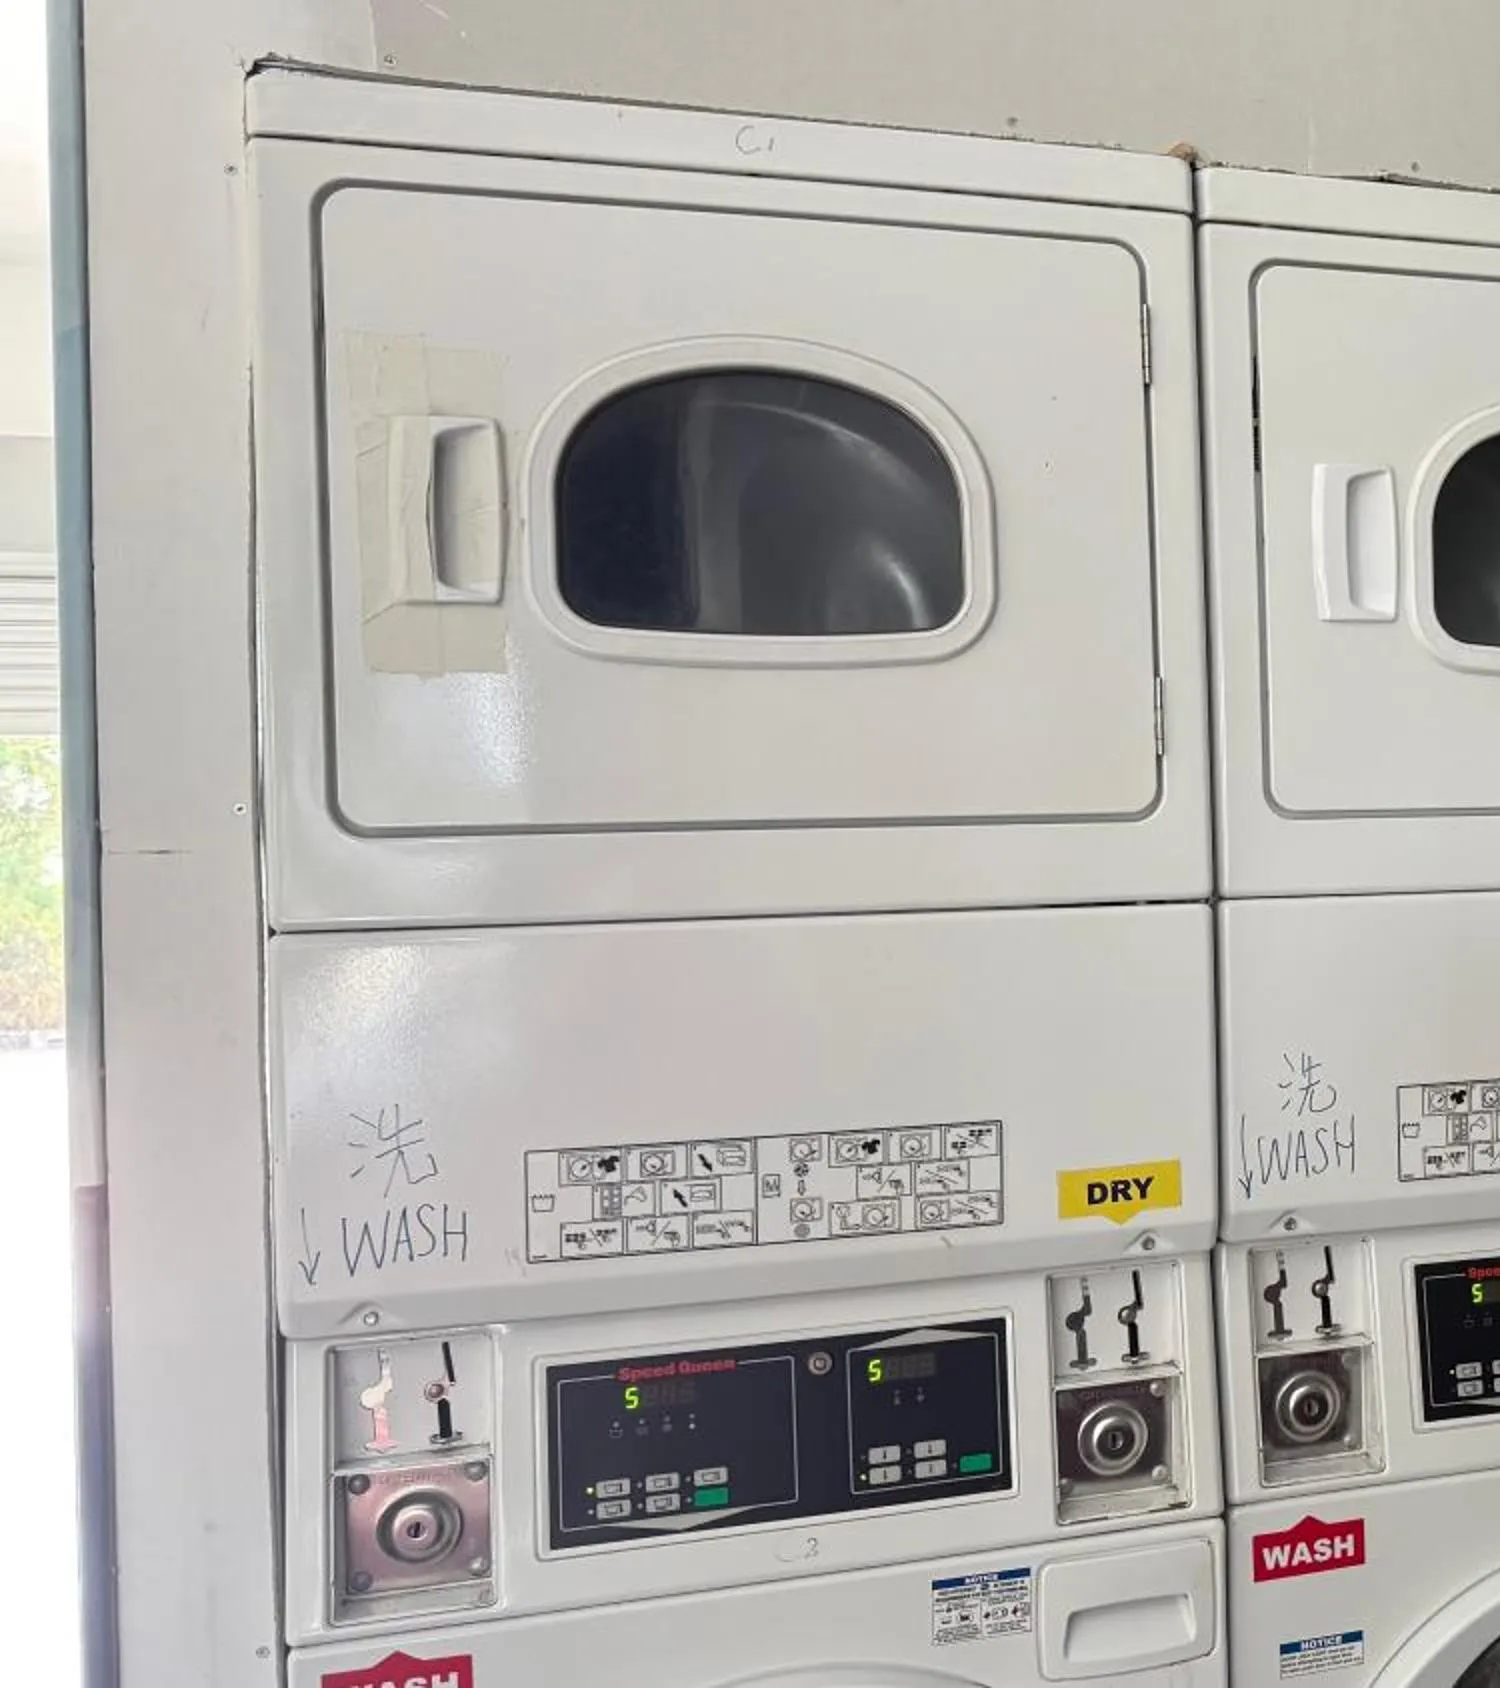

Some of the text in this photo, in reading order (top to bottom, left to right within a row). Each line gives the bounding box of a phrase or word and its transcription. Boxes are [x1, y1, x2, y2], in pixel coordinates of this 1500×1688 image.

[1278, 1052, 1337, 1117] 洗
[347, 1103, 439, 1198] 洗
[1257, 1113, 1355, 1185] WASH
[1087, 1176, 1155, 1206] DRY
[341, 1202, 468, 1277] WASH
[618, 1362, 676, 1382] Speed
[1261, 1533, 1356, 1571] WASH
[1301, 1635, 1343, 1651] NOTICE
